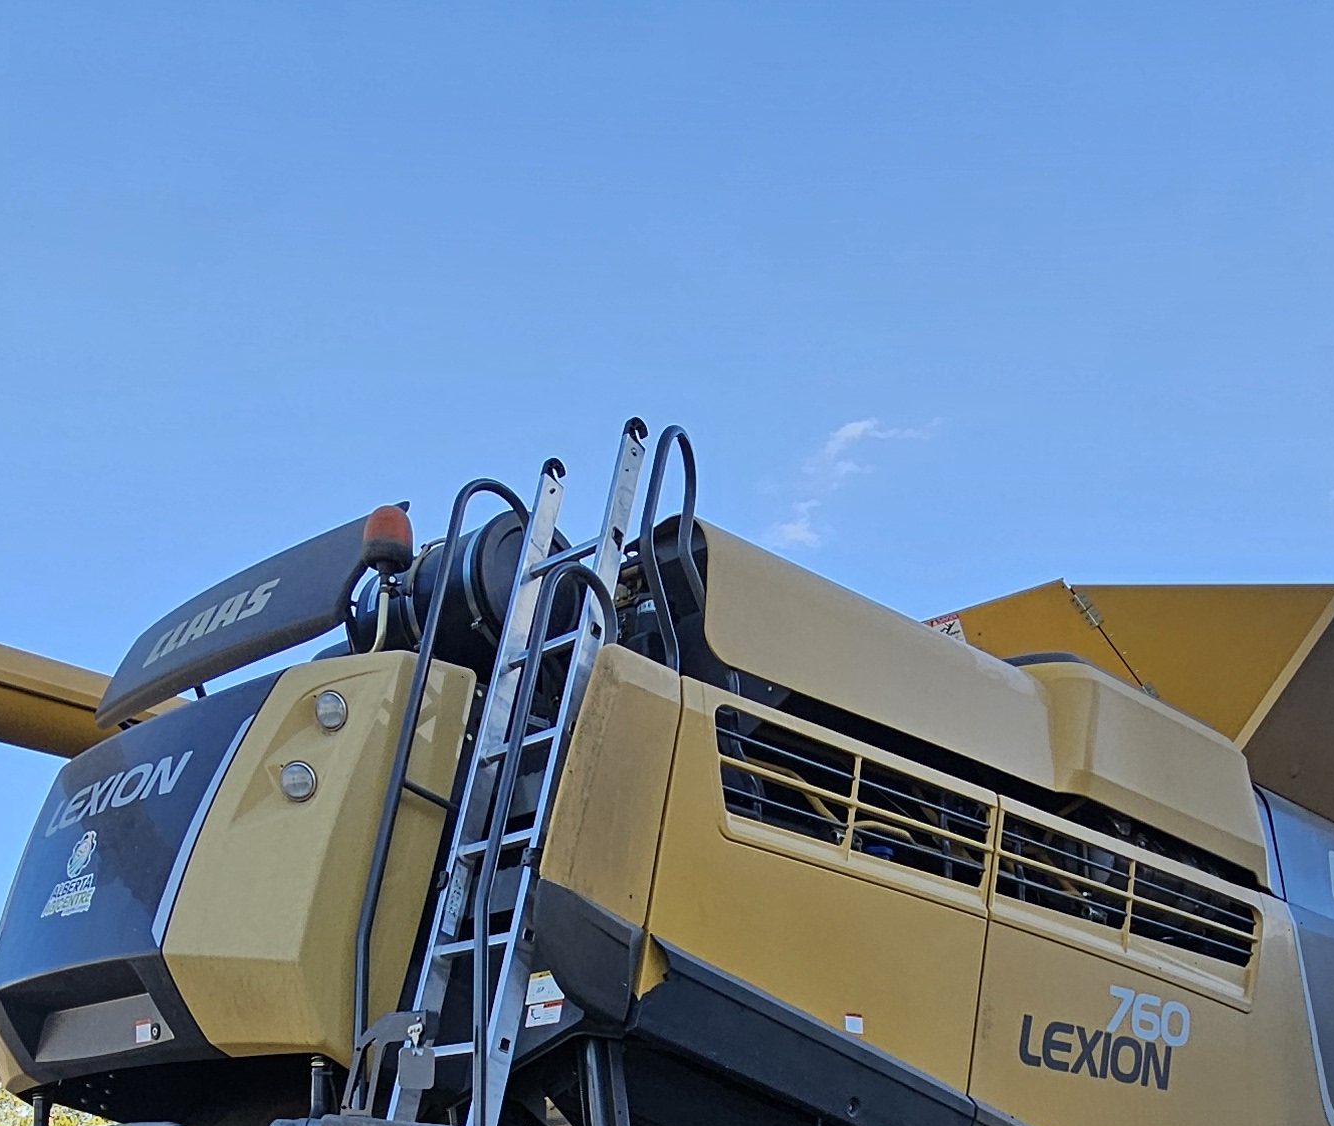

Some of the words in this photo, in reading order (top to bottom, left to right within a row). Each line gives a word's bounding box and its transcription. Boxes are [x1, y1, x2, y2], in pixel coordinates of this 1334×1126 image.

[142, 578, 281, 669] CLAAS
[45, 750, 194, 837] LEXION
[50, 874, 94, 898] ALBERTA
[1019, 1014, 1172, 1091] LEXION
[1109, 984, 1191, 1047] 760
